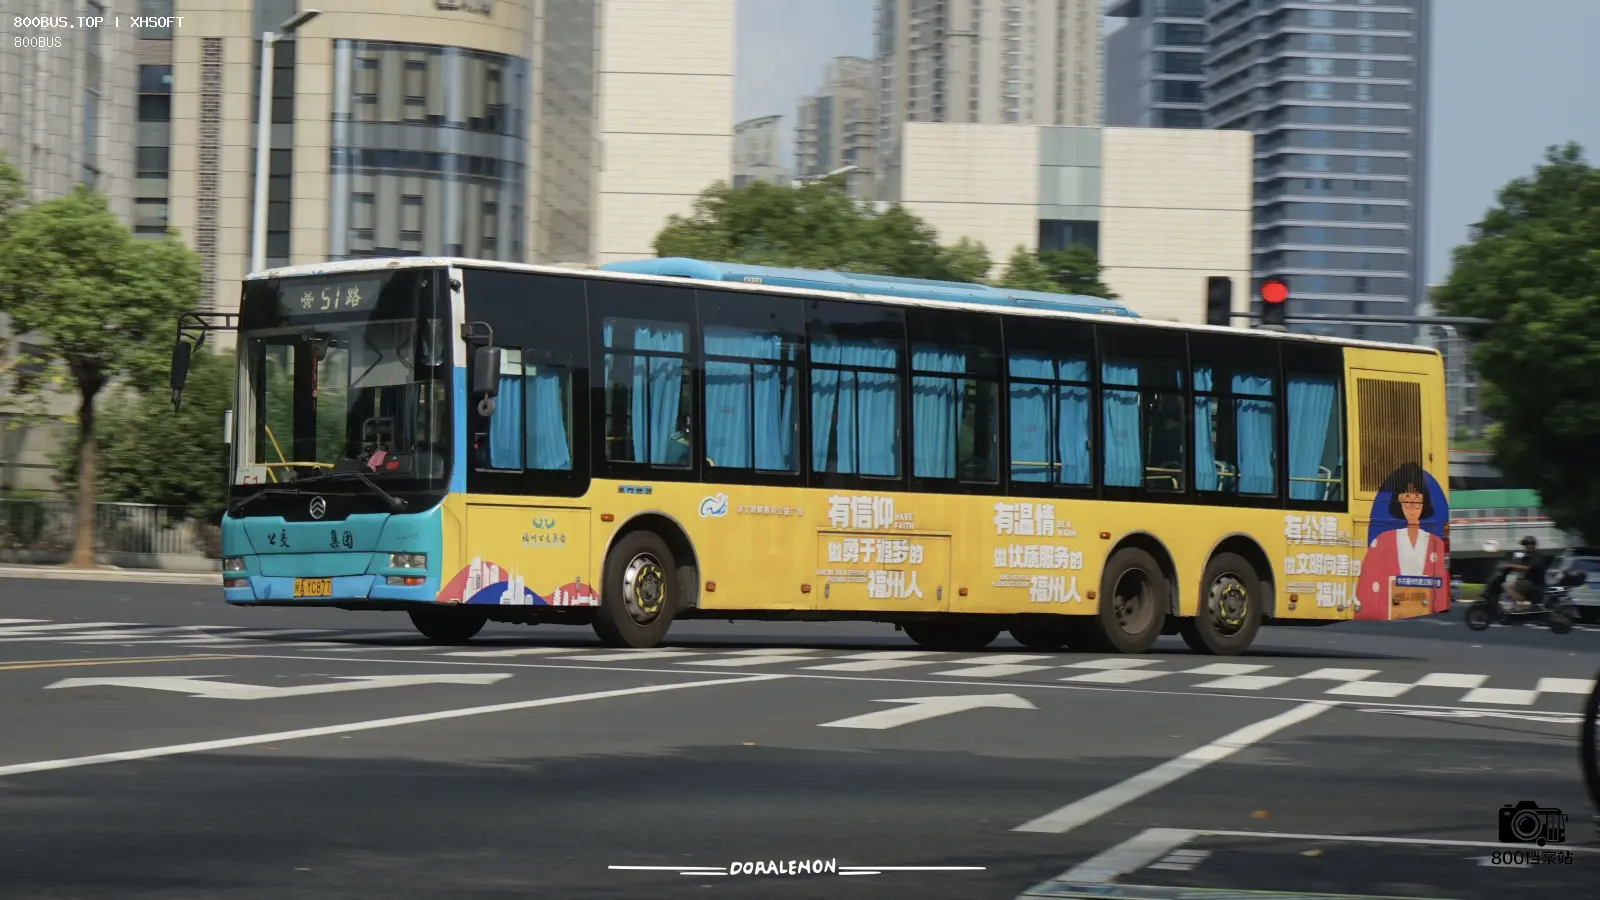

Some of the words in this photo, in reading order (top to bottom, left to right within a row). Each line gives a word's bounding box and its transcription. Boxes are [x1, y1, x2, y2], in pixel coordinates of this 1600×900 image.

[828, 494, 894, 529] 有信仰
[895, 513, 914, 521] HAVE
[993, 502, 1055, 536] 有温情
[895, 521, 914, 530] FAITH
[828, 537, 924, 565] 做勇于追梦的
[993, 544, 1083, 570] 做优质服务的
[1284, 553, 1361, 576] 做文明向善的
[868, 570, 924, 599] 福州人
[1030, 575, 1081, 603] 福州人
[1316, 582, 1361, 608] 福州人
